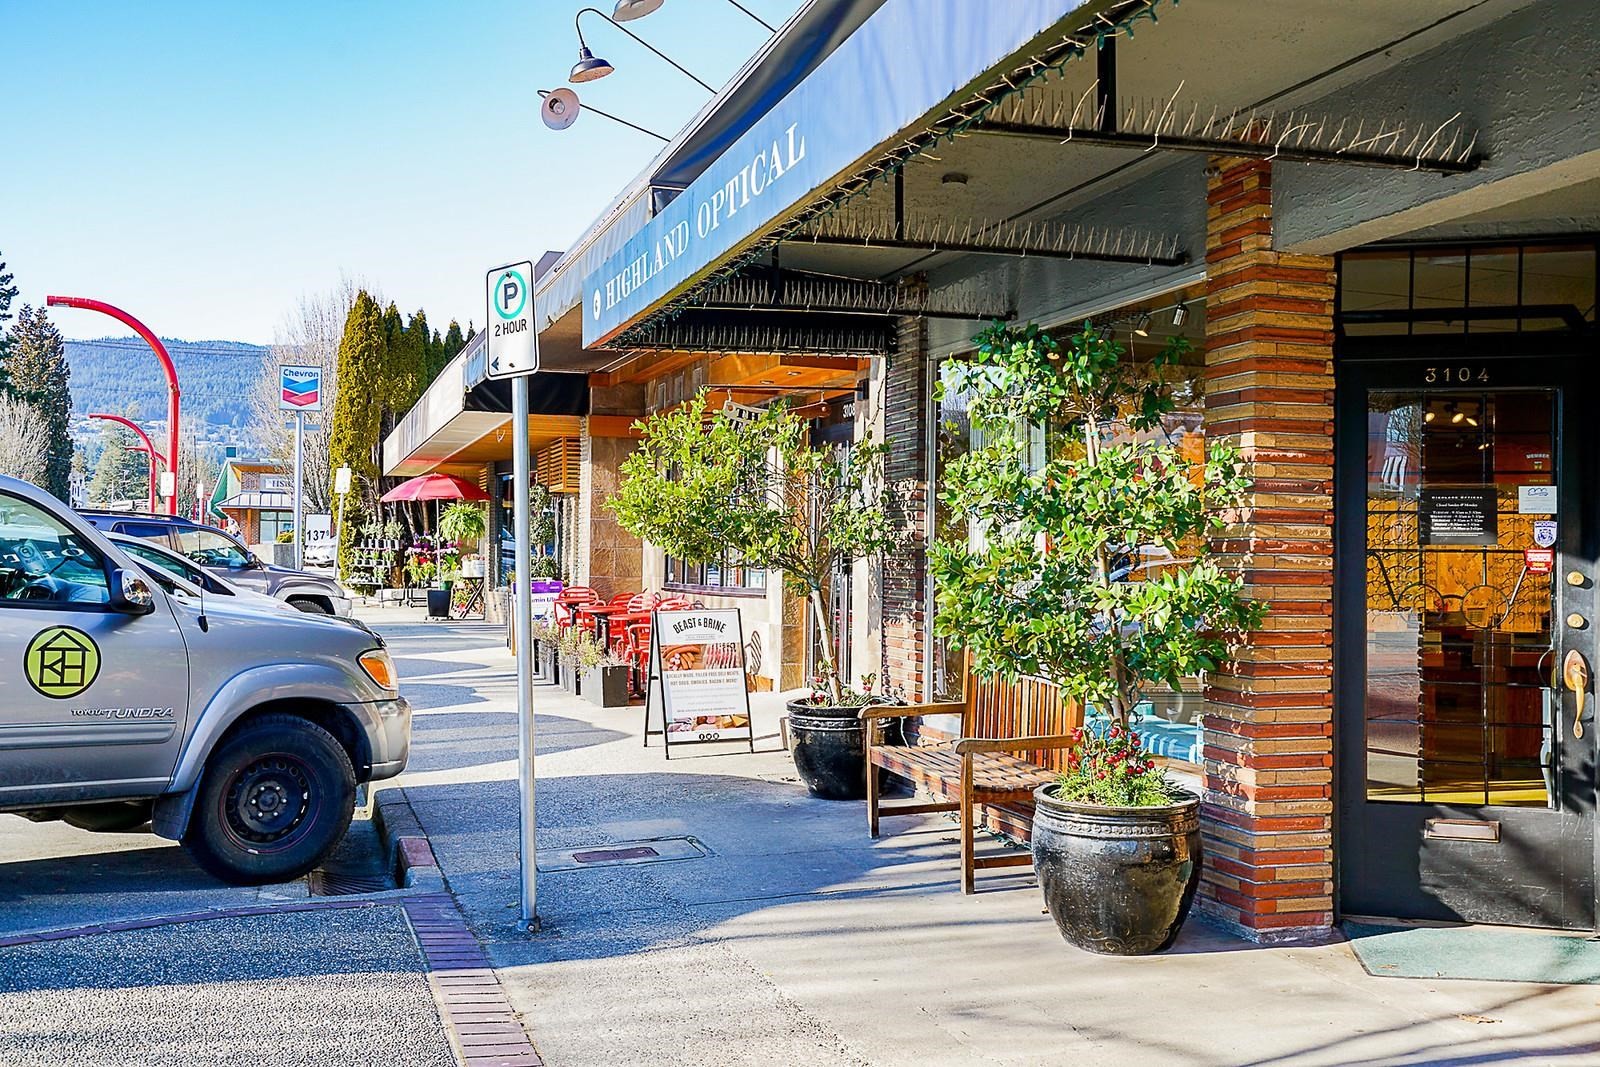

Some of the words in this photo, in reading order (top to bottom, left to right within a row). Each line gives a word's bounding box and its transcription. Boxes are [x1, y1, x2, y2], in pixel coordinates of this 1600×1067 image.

[605, 219, 690, 311] HIGHLAND
[697, 122, 805, 239] OPTICAL
[503, 282, 518, 309] P
[494, 324, 500, 337] 2
[502, 318, 527, 335] HOUR
[283, 369, 319, 377] Chevron
[1425, 367, 1489, 382] 3104
[672, 617, 697, 634] BEAST
[703, 617, 727, 633] BRINE
[71, 708, 104, 716] TOYOTA
[103, 707, 174, 719] TUNDRA
